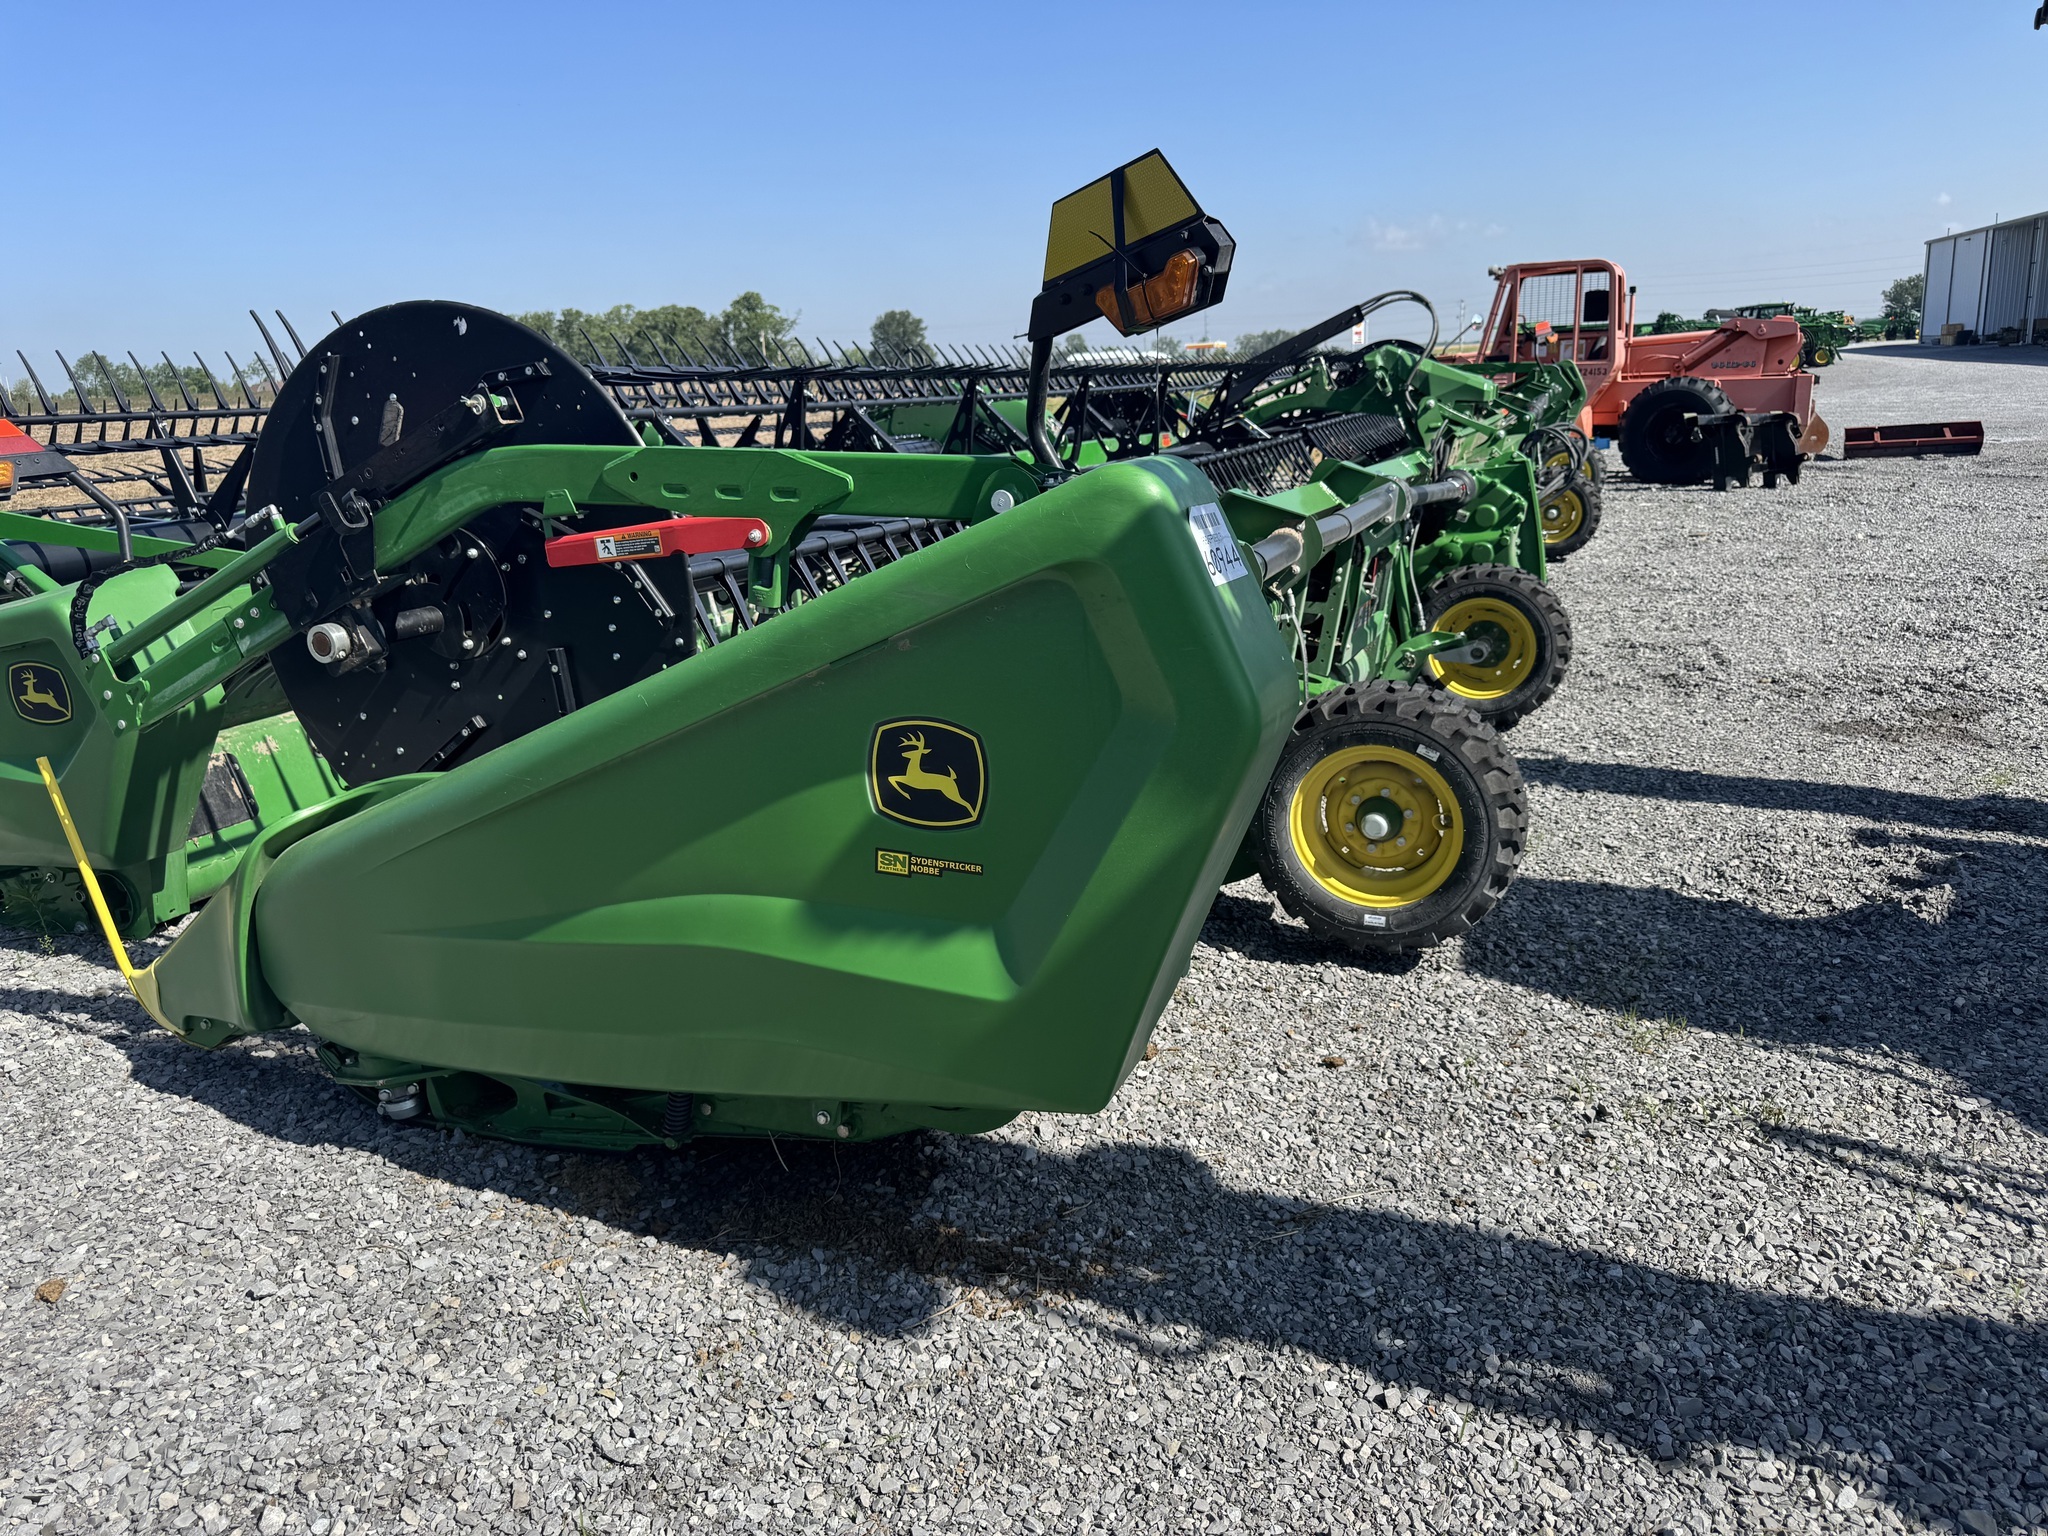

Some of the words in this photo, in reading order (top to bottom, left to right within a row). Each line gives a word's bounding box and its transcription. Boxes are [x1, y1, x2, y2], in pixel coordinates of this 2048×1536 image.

[880, 852, 907, 869] SN
[910, 856, 982, 873] SYDENSTRICKER
[879, 865, 907, 873] PARTNERS
[910, 865, 940, 875] NOBBE
